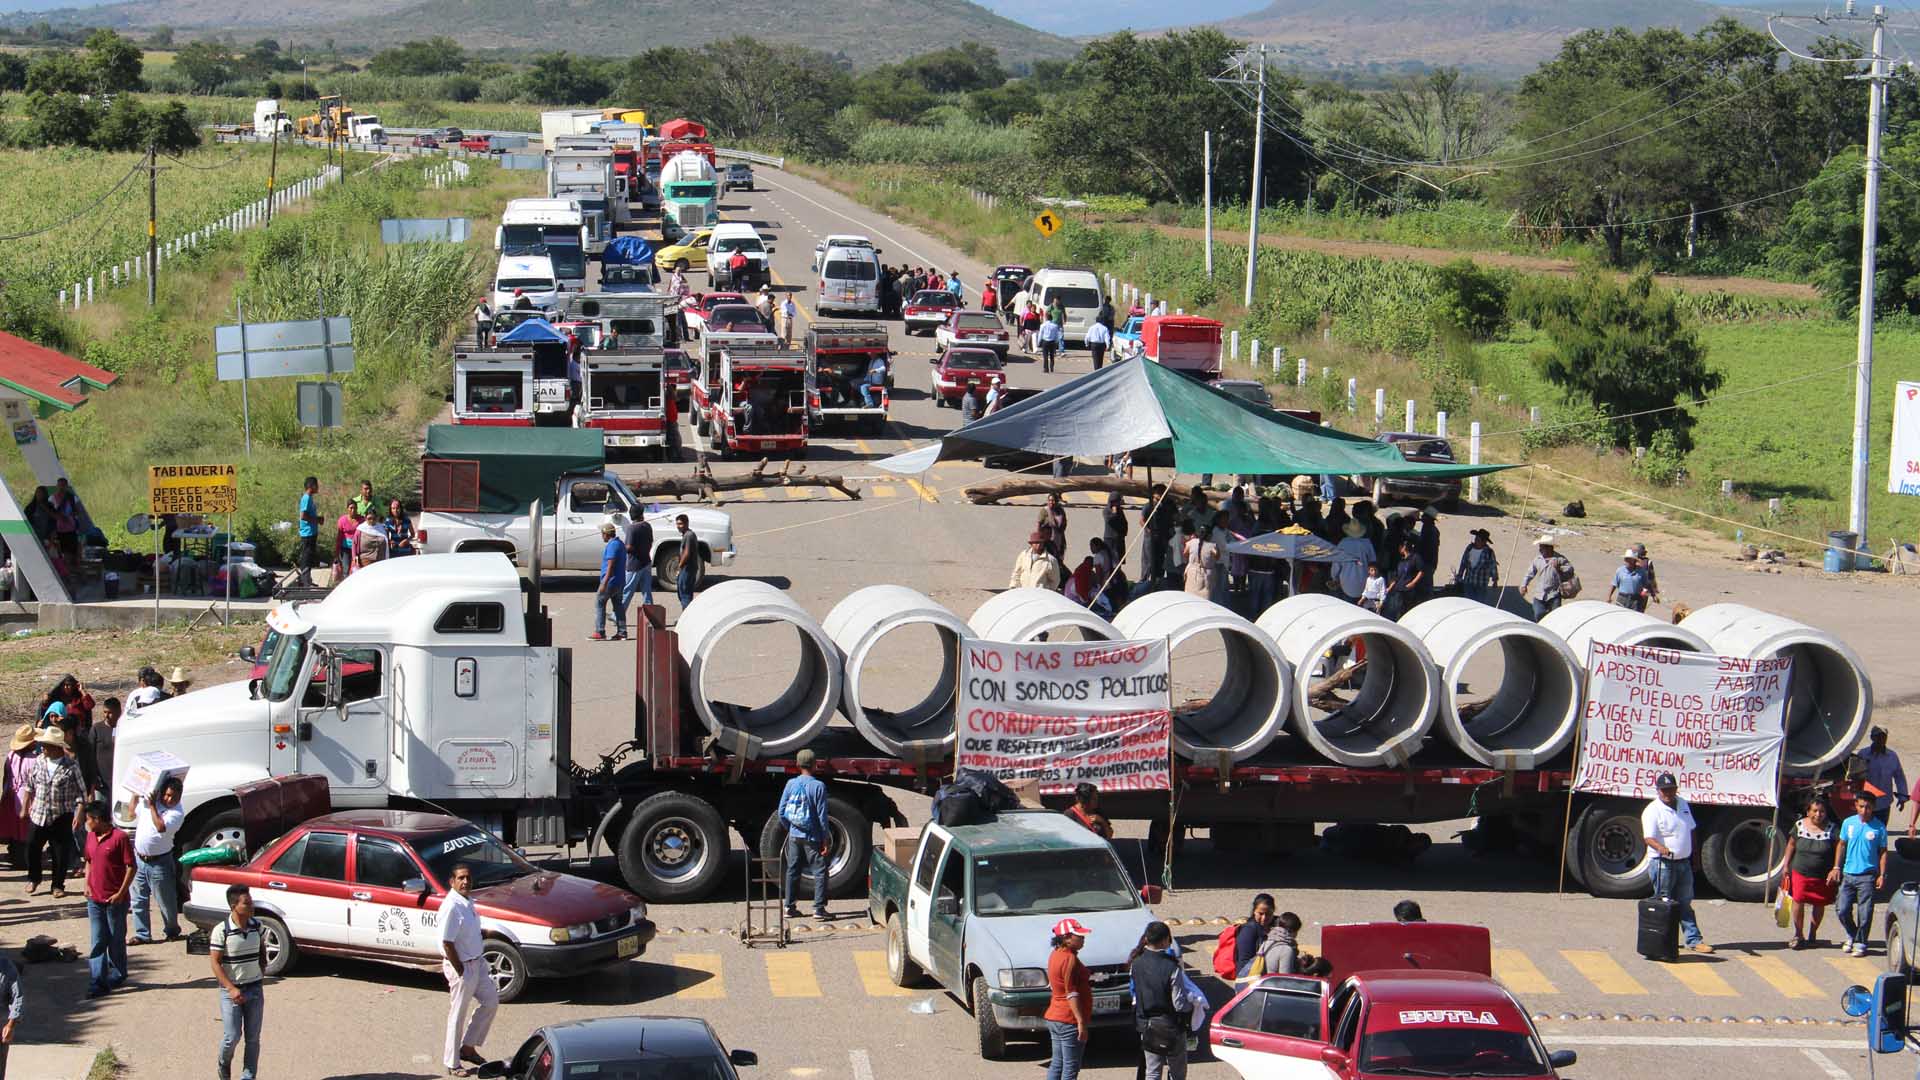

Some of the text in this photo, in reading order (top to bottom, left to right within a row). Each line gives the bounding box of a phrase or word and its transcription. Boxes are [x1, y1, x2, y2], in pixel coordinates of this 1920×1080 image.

[153, 465, 234, 477] TABIQUERIA
[153, 486, 202, 496] OFRECE
[153, 495, 202, 504] PESADO
[153, 503, 203, 512] LIGERO
[970, 645, 1149, 672] NO MAS DIALOGO
[1593, 641, 1681, 665] SANTIAGO
[1717, 655, 1751, 673] SAN
[1595, 662, 1779, 691] APOSTOL MARTIR
[969, 673, 1168, 703] CON SORDOS POLITICOS
[968, 708, 1079, 736] CORRUPTOS
[1585, 700, 1757, 733] EXIGEN EL DERECHO DE
[1605, 723, 1634, 743] LOS
[964, 738, 993, 751] QUE
[998, 736, 1056, 754] RESPETEN
[1065, 767, 1074, 779] Y
[1077, 757, 1169, 779] DOCUMENTACIÓN
[1711, 752, 1761, 772] LIBROS
[1586, 763, 1714, 790] UTILES ESCARES
